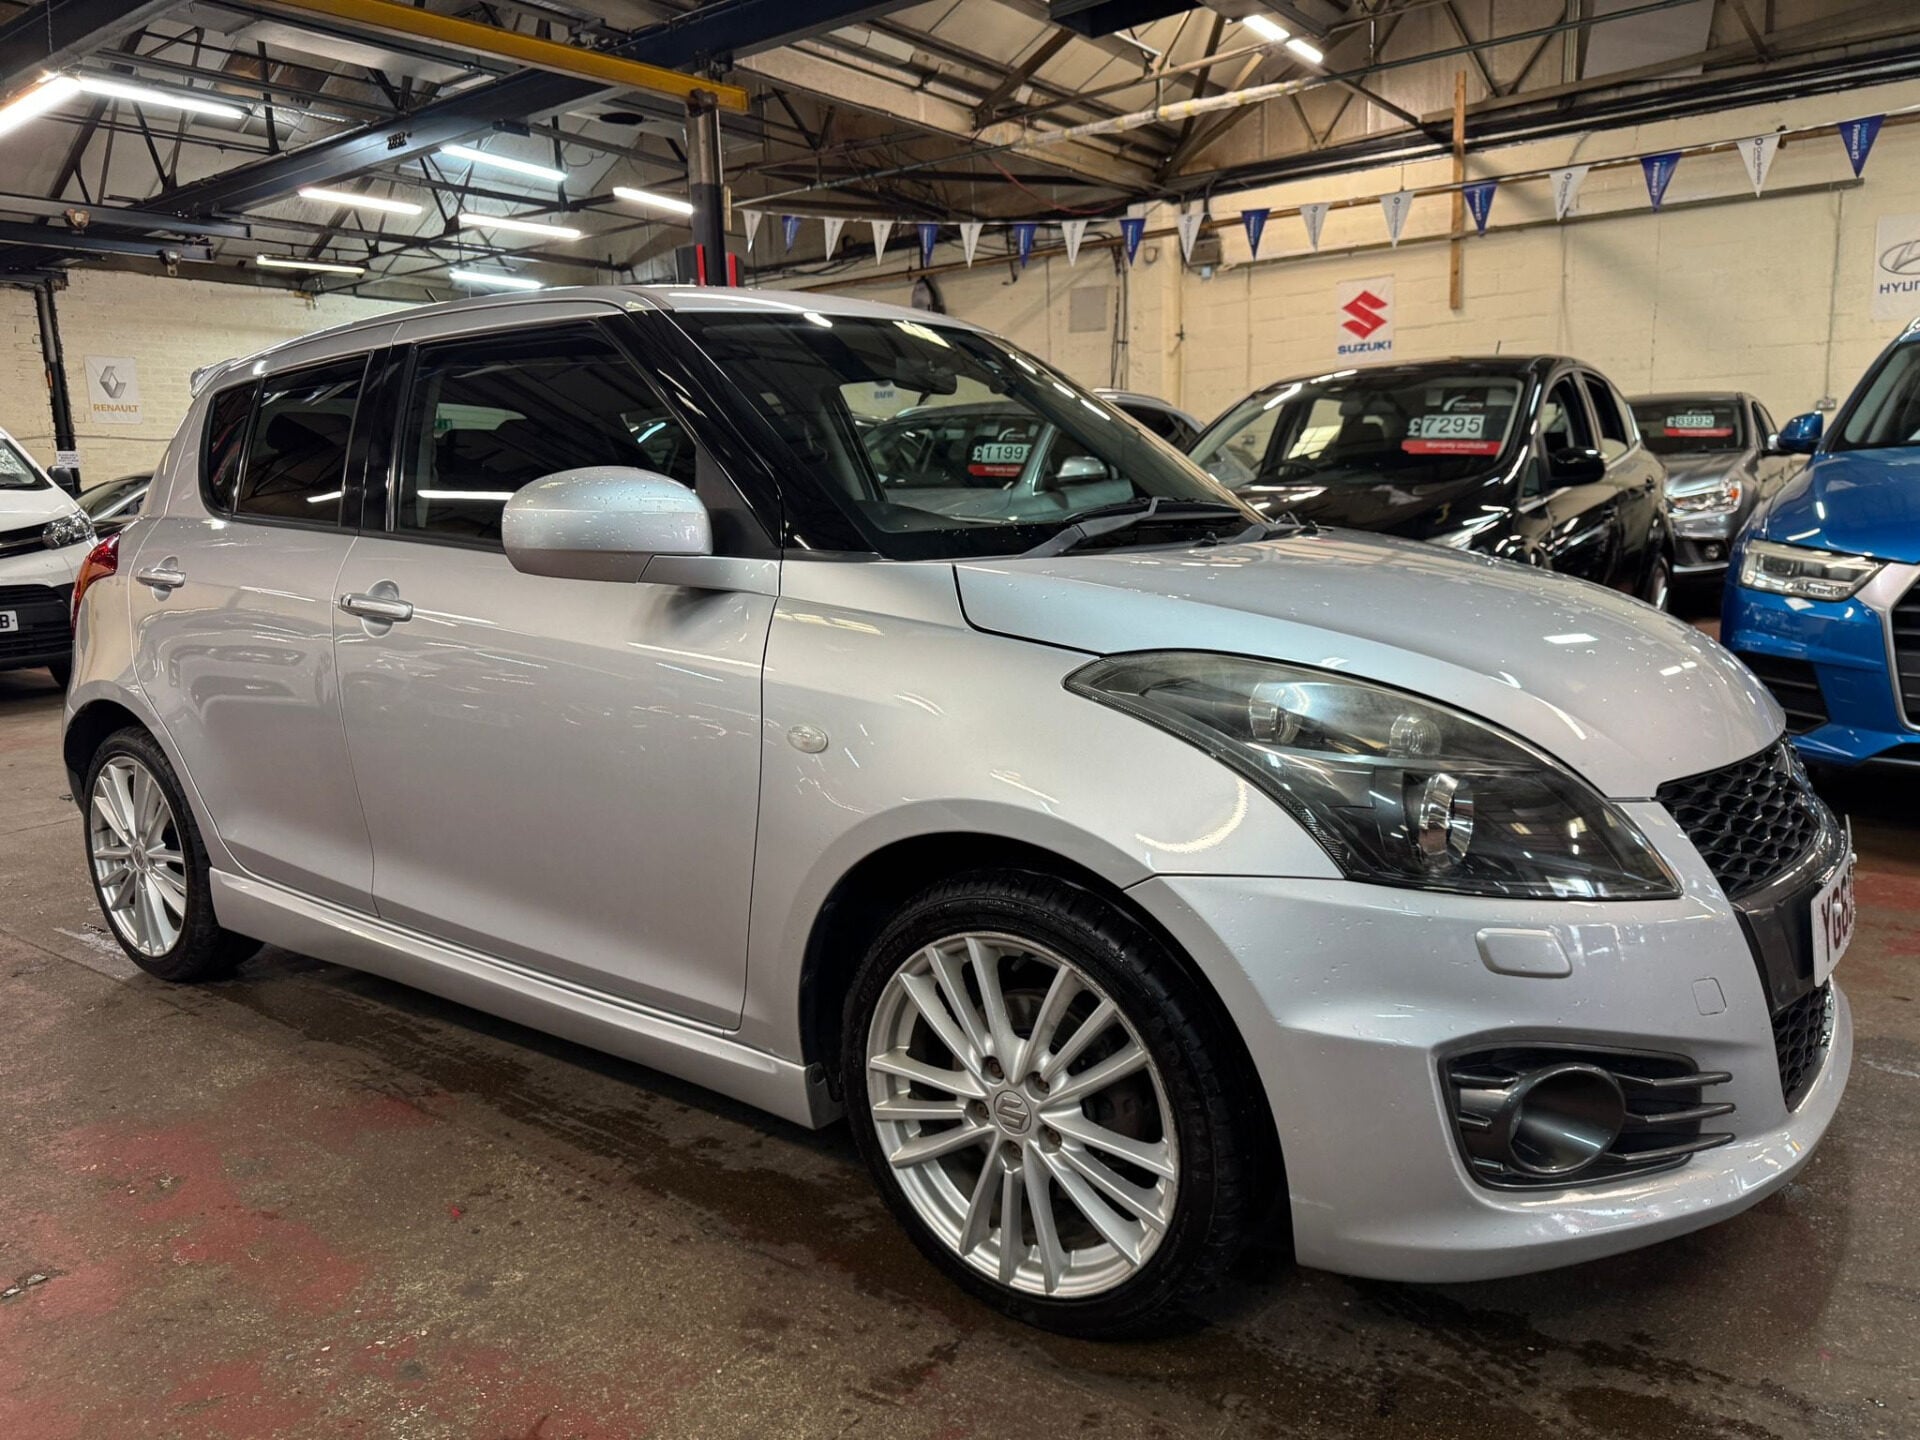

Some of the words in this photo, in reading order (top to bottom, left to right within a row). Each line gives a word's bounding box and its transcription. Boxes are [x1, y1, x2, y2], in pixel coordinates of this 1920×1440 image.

[1337, 340, 1392, 355] SUZUKI
[93, 403, 139, 413] RENAULT
[1407, 416, 1481, 437] £7295
